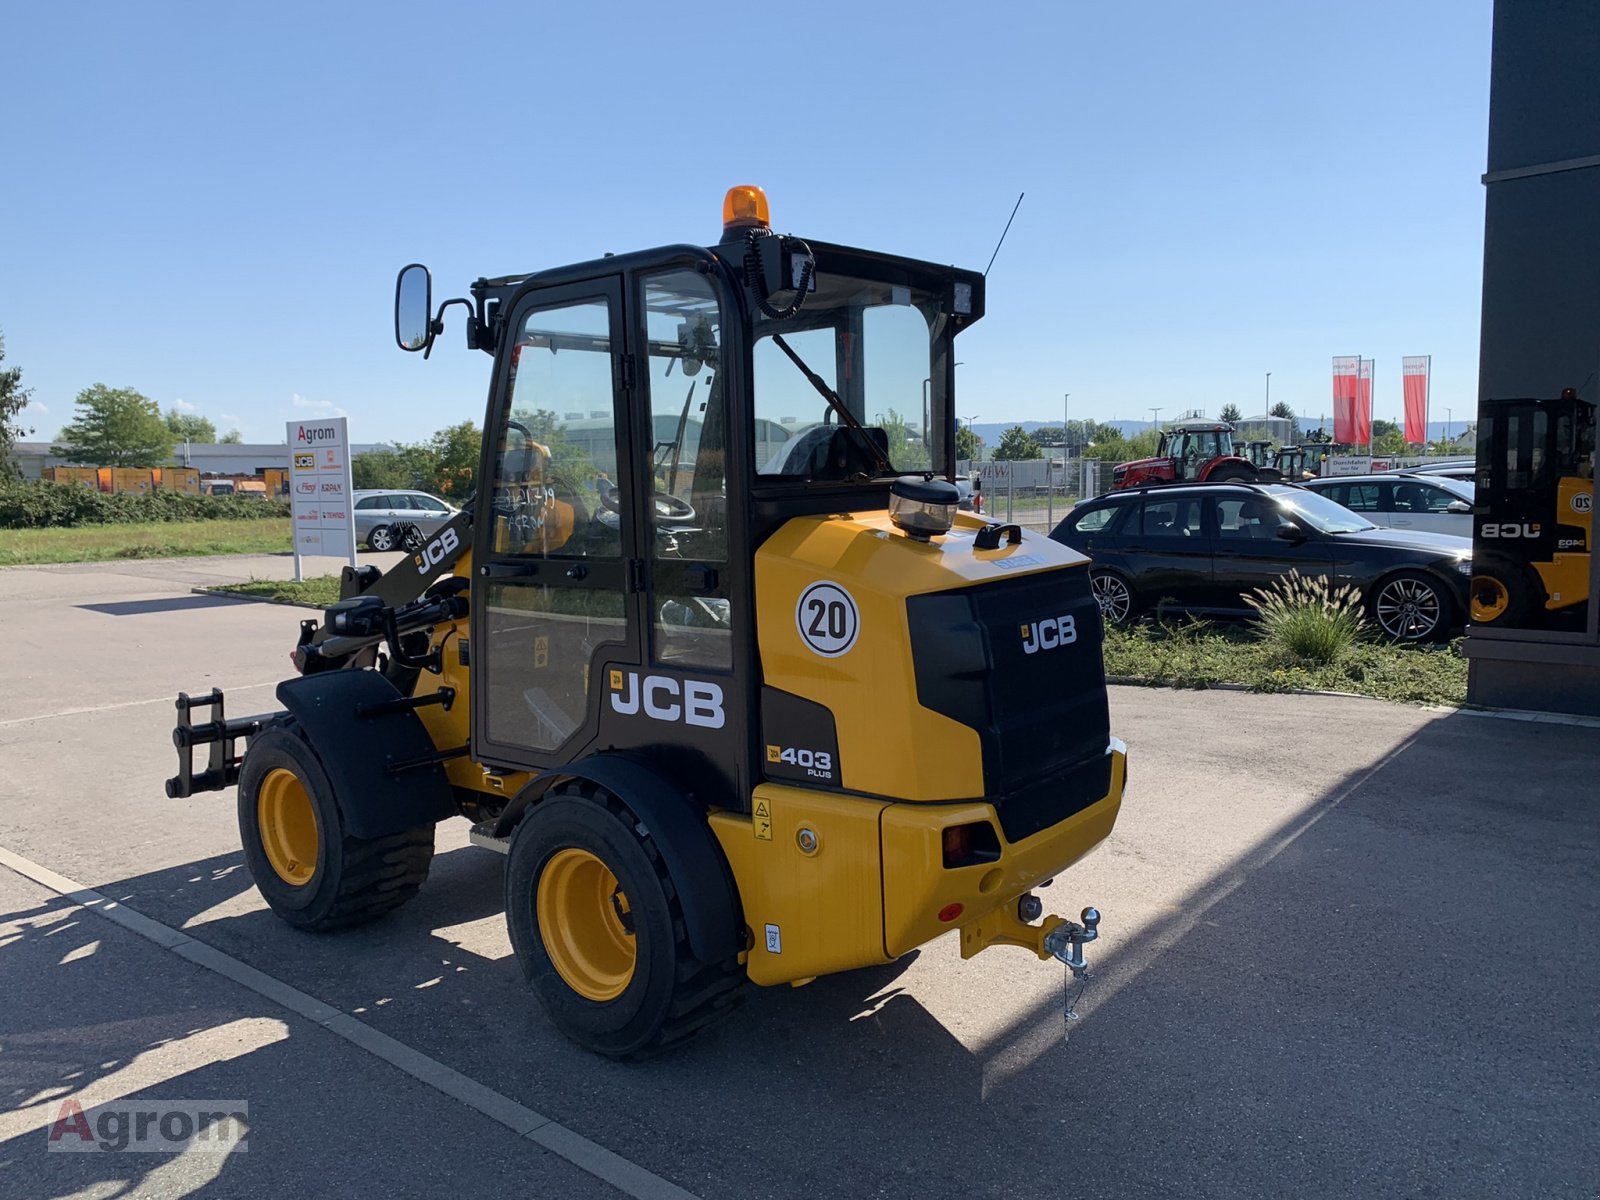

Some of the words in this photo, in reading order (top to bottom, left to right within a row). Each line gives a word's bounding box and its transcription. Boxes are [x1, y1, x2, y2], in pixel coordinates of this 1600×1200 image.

[298, 425, 335, 444] Agrom
[295, 456, 313, 467] JCB
[415, 527, 459, 575] JCB
[808, 598, 847, 639] 20
[1021, 615, 1077, 654] JCB
[610, 671, 725, 729] JCB
[780, 748, 832, 770] 403
[807, 768, 832, 779] PLUS
